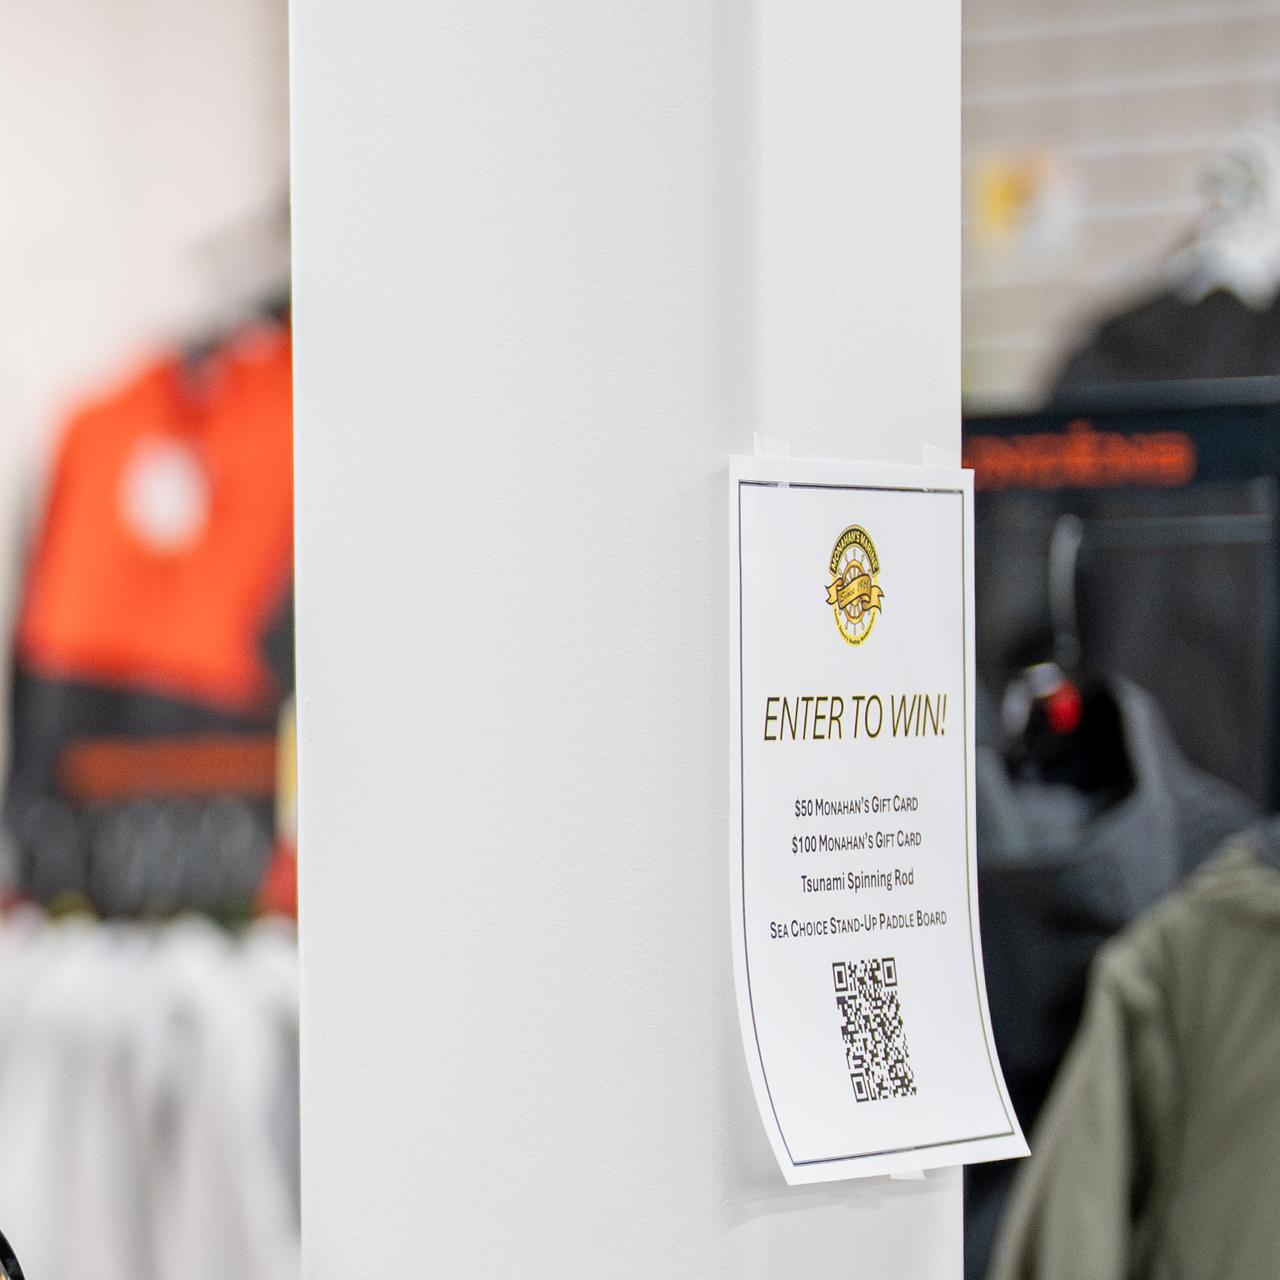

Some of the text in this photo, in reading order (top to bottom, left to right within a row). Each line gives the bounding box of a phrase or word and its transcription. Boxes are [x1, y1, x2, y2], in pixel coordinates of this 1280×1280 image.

[830, 531, 878, 571] MONAHAN'S MARINE
[763, 693, 947, 741] ENTER TO WIN!
[794, 798, 813, 818] $50
[791, 834, 817, 855] $100
[800, 868, 915, 893] Tsunami Spinning Rod
